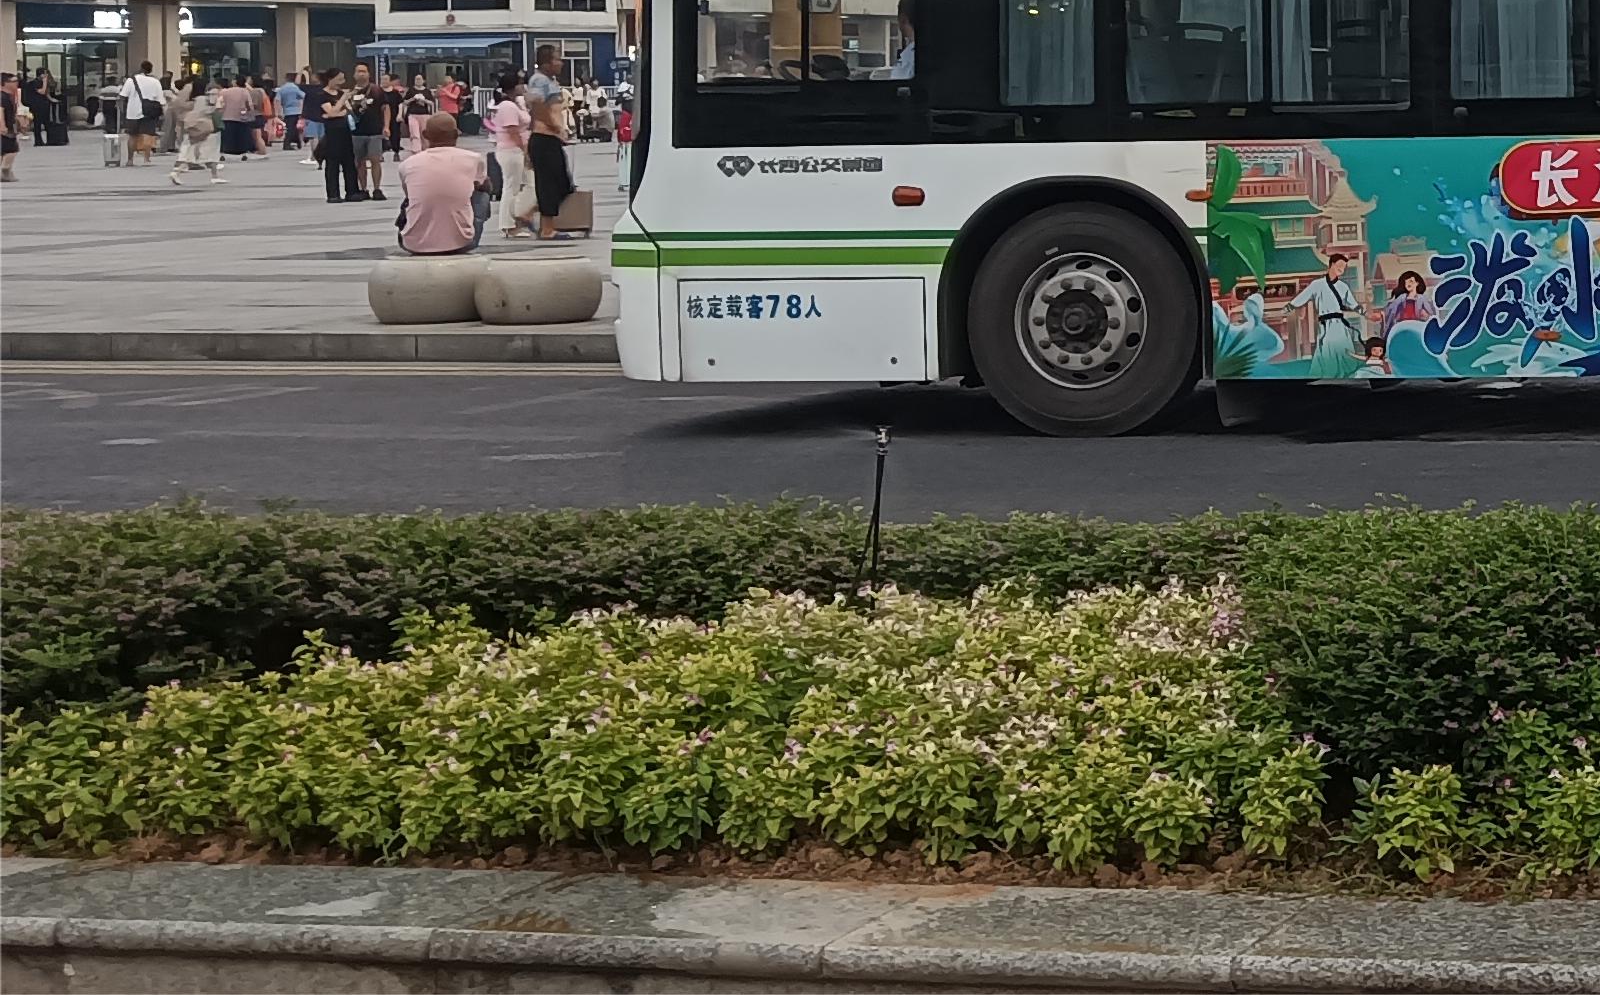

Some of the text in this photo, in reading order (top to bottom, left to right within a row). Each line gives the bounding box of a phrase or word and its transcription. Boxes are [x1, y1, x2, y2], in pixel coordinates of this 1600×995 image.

[686, 294, 822, 320] 核定载客78人
